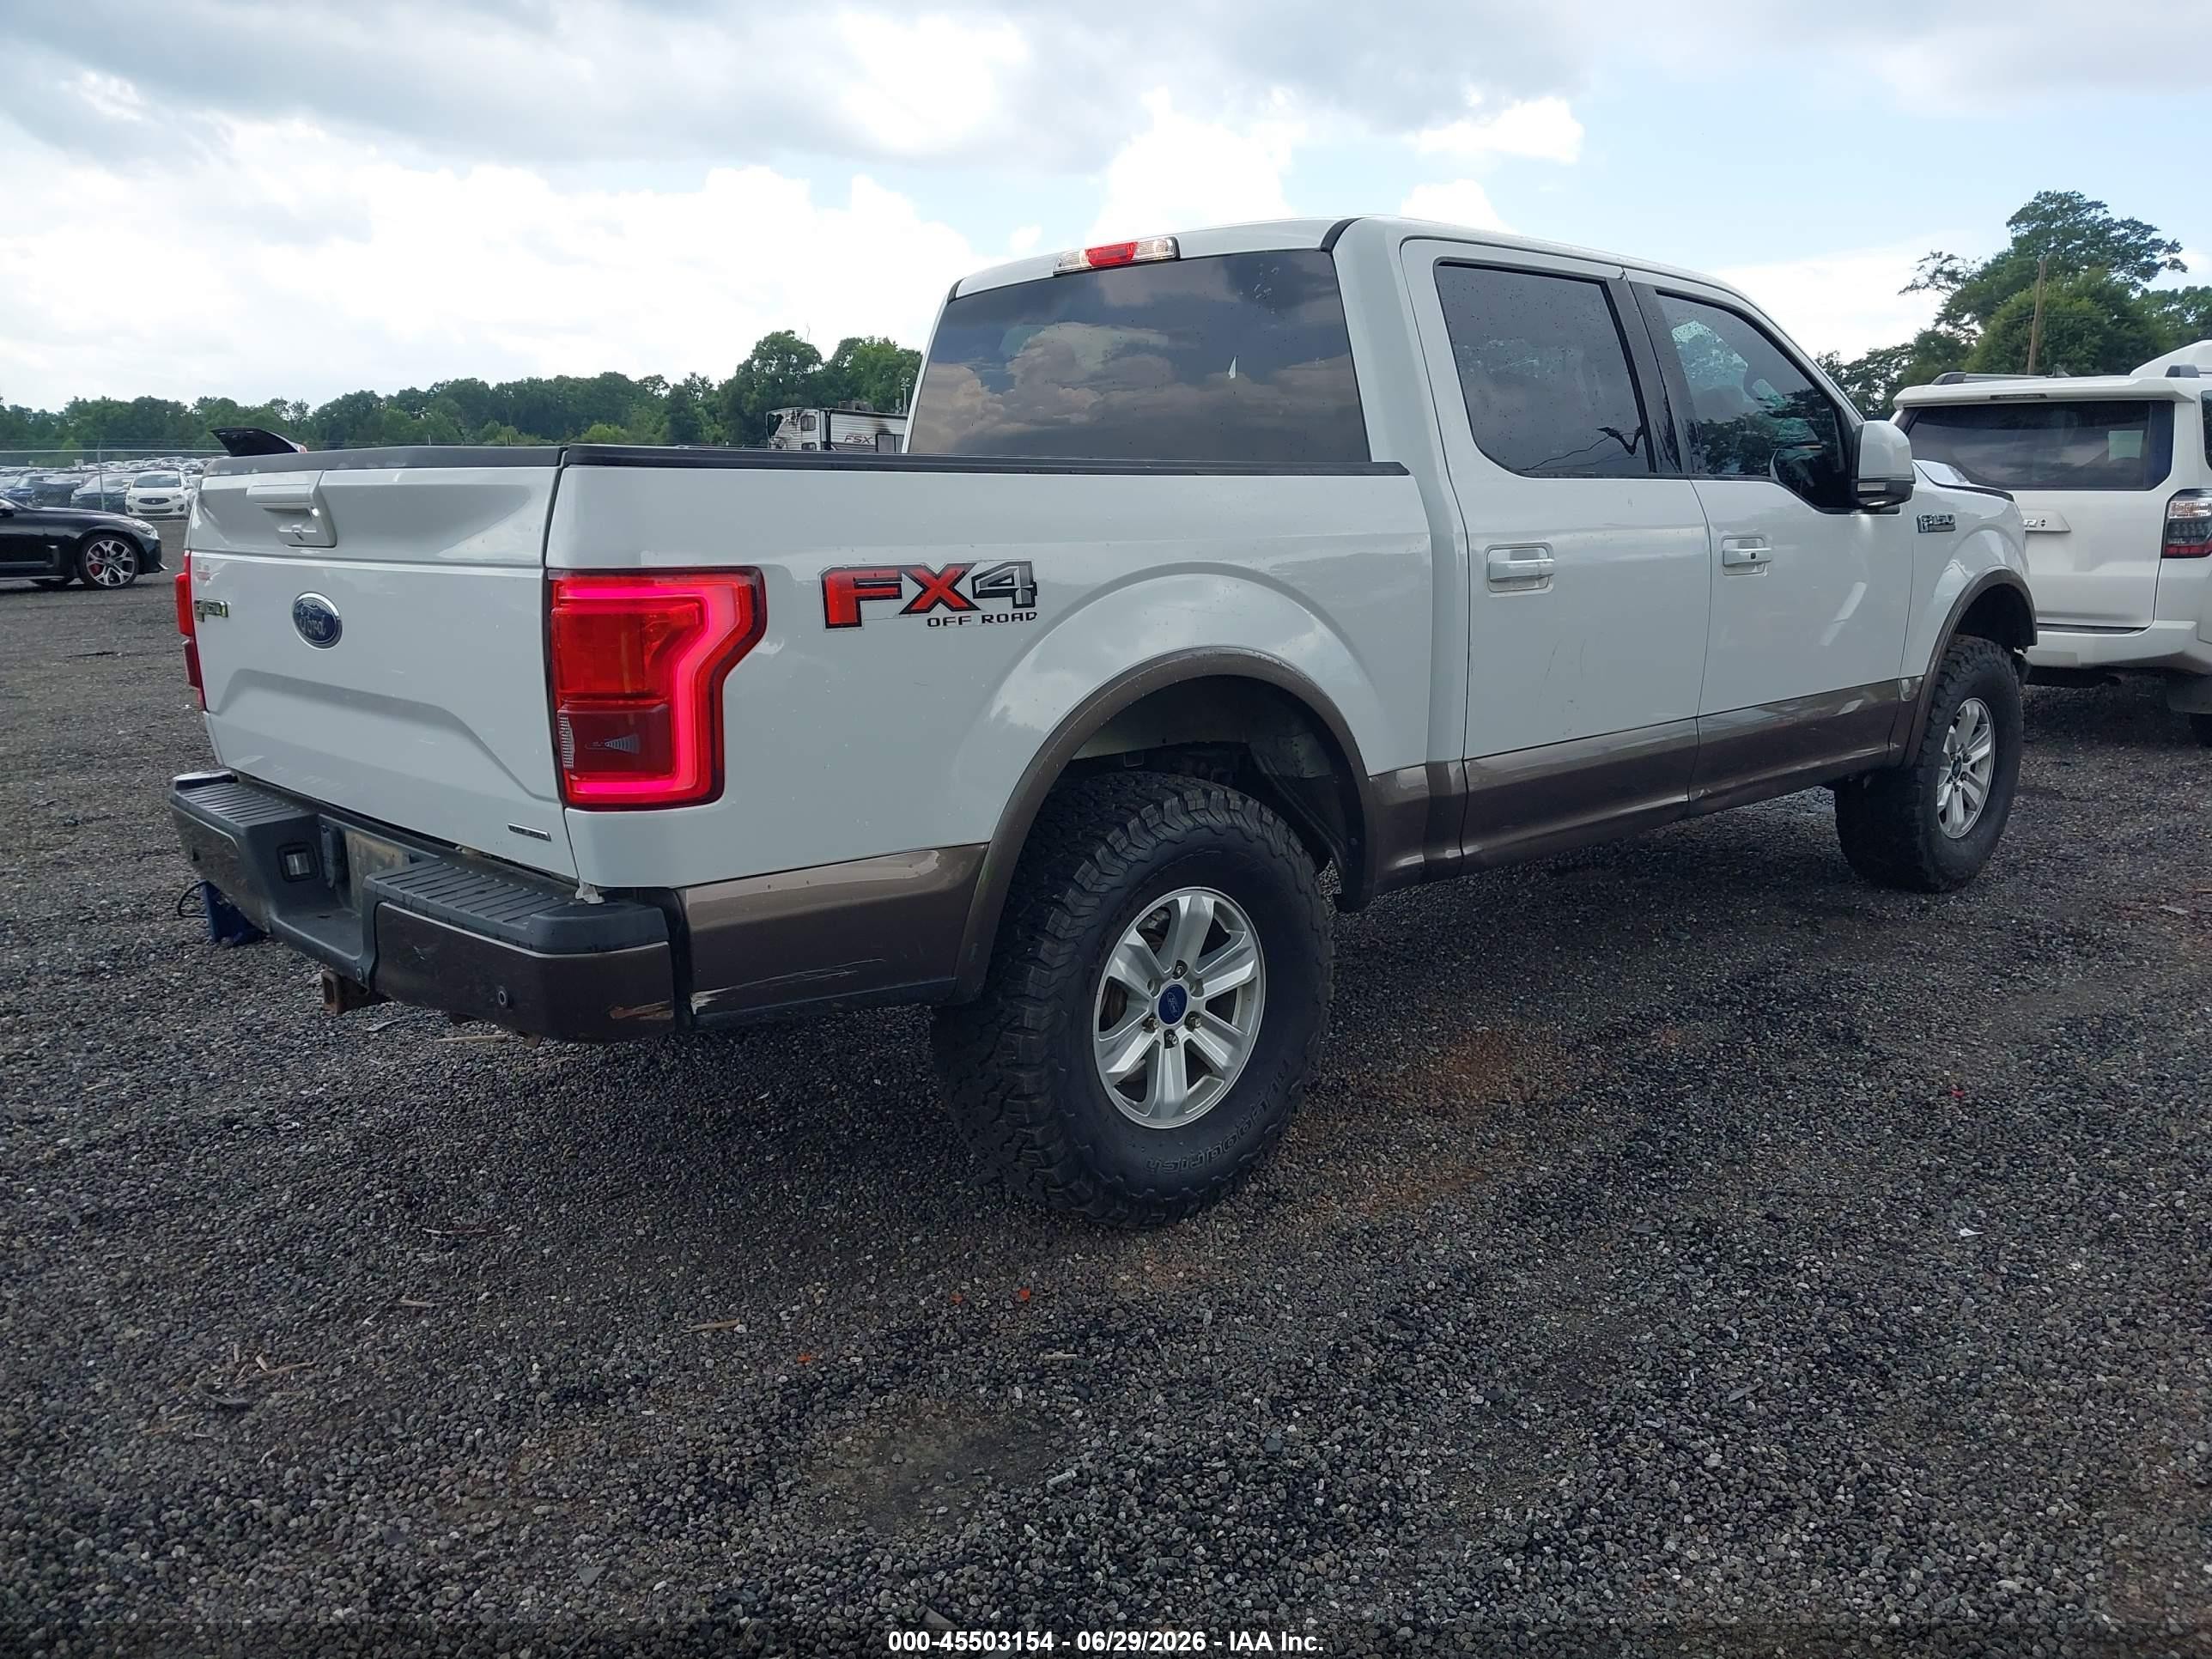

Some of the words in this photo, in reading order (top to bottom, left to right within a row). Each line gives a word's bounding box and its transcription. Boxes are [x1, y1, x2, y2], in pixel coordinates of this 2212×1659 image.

[844, 434, 872, 444] FSX
[822, 562, 1037, 629] FX4
[299, 604, 327, 635] Ford
[927, 617, 972, 628] OFF
[981, 611, 1037, 624] ROAD
